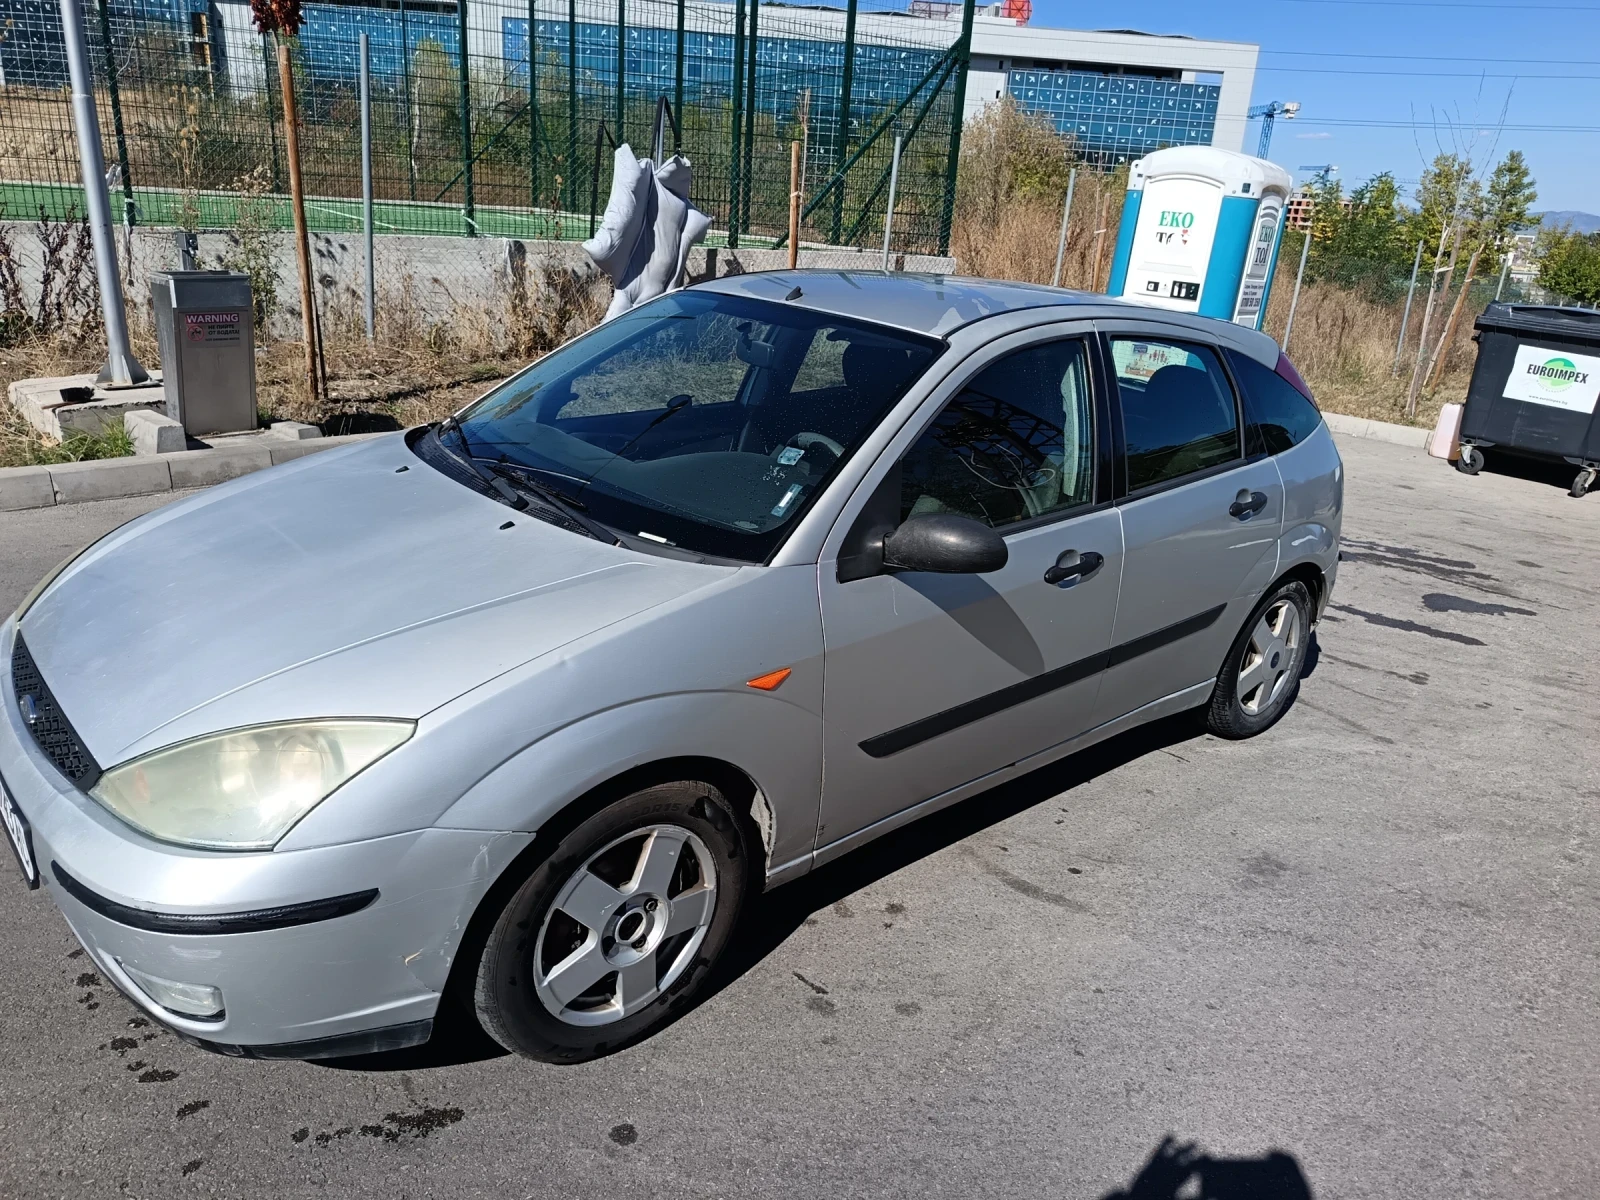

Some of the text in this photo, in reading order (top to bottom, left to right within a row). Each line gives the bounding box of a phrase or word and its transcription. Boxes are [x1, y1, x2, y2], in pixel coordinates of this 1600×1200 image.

[1158, 210, 1194, 229] EKO
[186, 313, 239, 323] WARNING
[1526, 363, 1590, 384] EUROIMPEX
